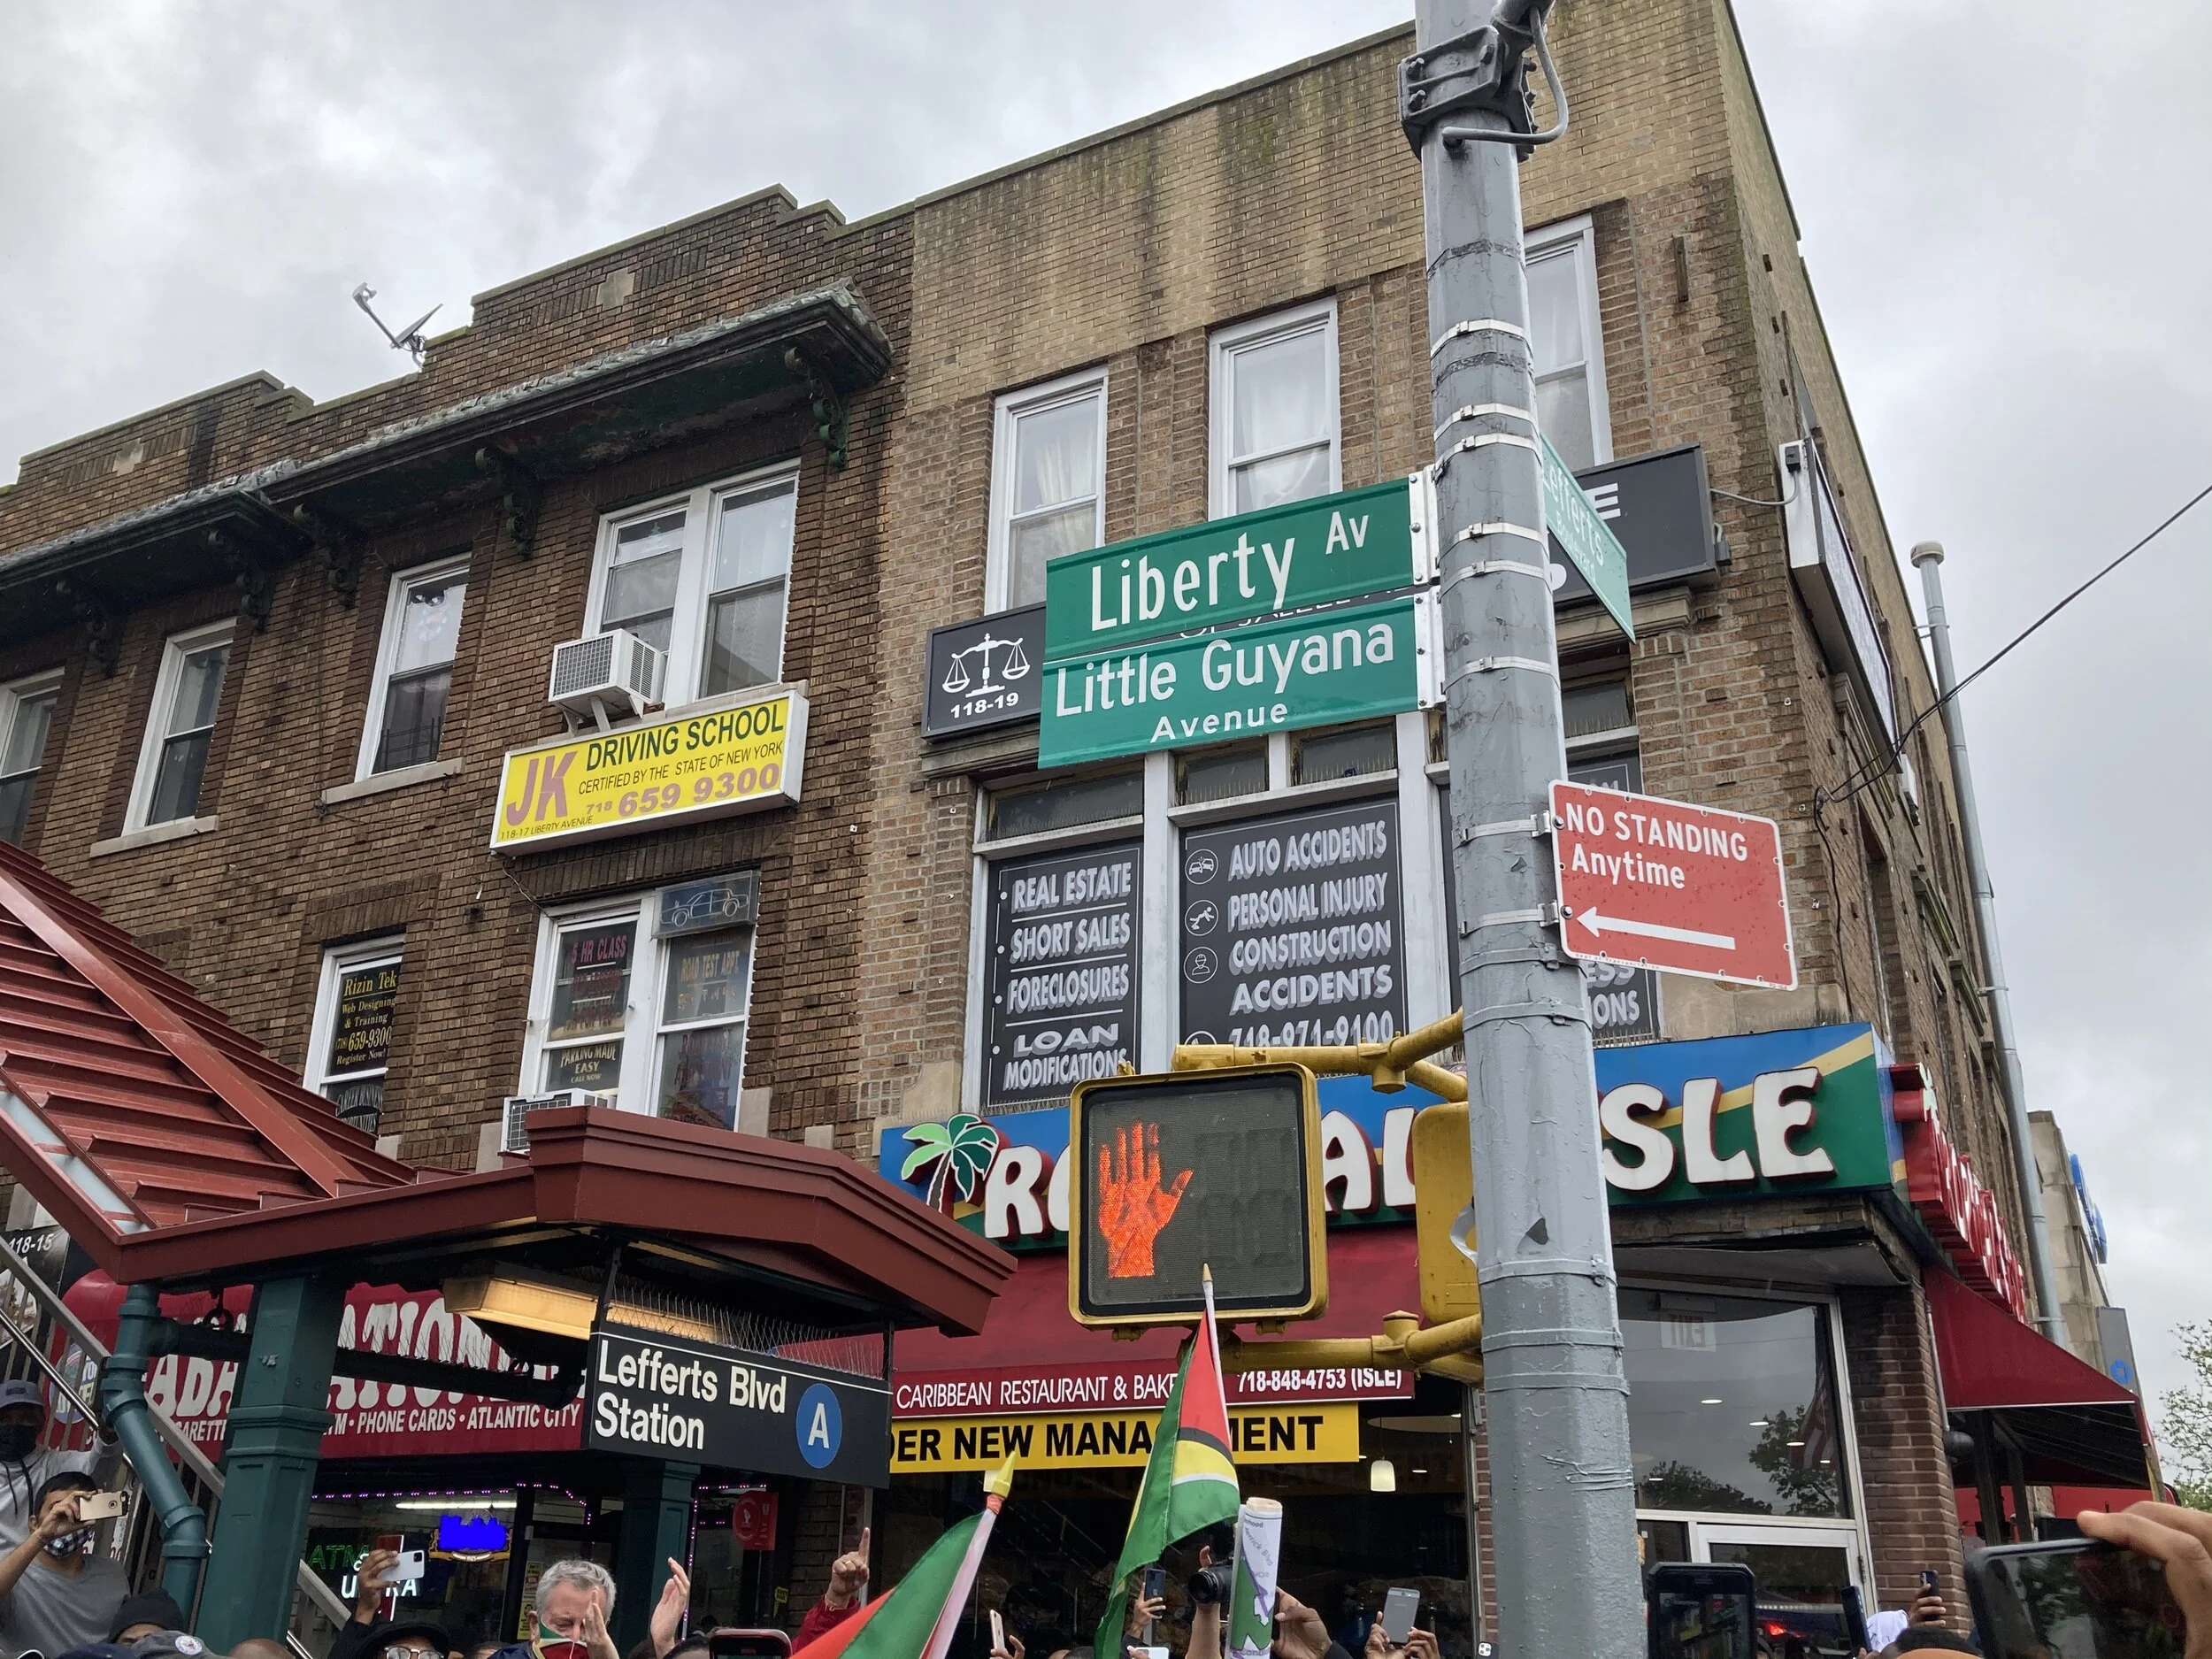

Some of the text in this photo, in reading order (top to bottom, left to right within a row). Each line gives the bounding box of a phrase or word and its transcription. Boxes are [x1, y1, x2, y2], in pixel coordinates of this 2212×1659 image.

[1092, 533, 1295, 632] Liberty
[1325, 511, 1369, 555] Av
[1056, 623, 1394, 718] Little Guyana
[950, 692, 1019, 718] 118-19
[1150, 703, 1288, 743] Avenue
[587, 703, 784, 772] DRIVING SCHOOL
[506, 751, 577, 826] JK
[579, 740, 783, 795] CERTIFIED BY THE STATE OF NEW YORK
[586, 763, 780, 817] 718 659 9300
[500, 815, 594, 841] 118-17 LIBERTY AVENUE
[1228, 819, 1387, 881] AUTO ACCIDENTS
[1565, 803, 1747, 862] NO STANDING
[1011, 862, 1132, 913] REAL ESTATE
[1571, 843, 1685, 889] Anytime
[1228, 872, 1387, 932] PERSONAL INJURY
[581, 940, 594, 963] HR
[597, 934, 627, 961] CLASS
[1010, 912, 1130, 964] SHORT SALES
[1229, 919, 1392, 974] CONSTRUCTION
[344, 970, 397, 996] Rizin Tek
[703, 953, 720, 979] TEST
[1007, 964, 1130, 1014] FORECLOSURES
[1229, 964, 1394, 1015] ACCIDENTS
[342, 996, 396, 1014] Web Designing
[344, 1013, 388, 1029] & Training
[336, 1048, 387, 1065] Register Now!
[348, 1025, 392, 1051] 659-9300
[560, 1043, 616, 1068] PARKING MADE
[1013, 1024, 1119, 1057] LOAN
[571, 1073, 602, 1084] CALL NOW
[575, 1062, 600, 1074] EASY
[1600, 1066, 1837, 1192] SLE
[598, 1340, 787, 1414] Lefferts Blvd
[896, 1380, 992, 1409] CARIBBEAN
[1000, 1375, 1108, 1407] RESTAURANT
[1113, 1377, 1128, 1401] &
[1237, 1368, 1348, 1394] 718-848-4753
[1350, 1368, 1402, 1391] (ISLE)
[357, 1409, 403, 1434] PHONE
[408, 1408, 456, 1432] CARDS
[467, 1404, 540, 1430] ATLANTIC
[543, 1403, 580, 1428] CITY
[595, 1392, 704, 1449] Station
[808, 1402, 830, 1449] A
[954, 1424, 1031, 1461] NEW
[1046, 1414, 1325, 1456] MANAENT
